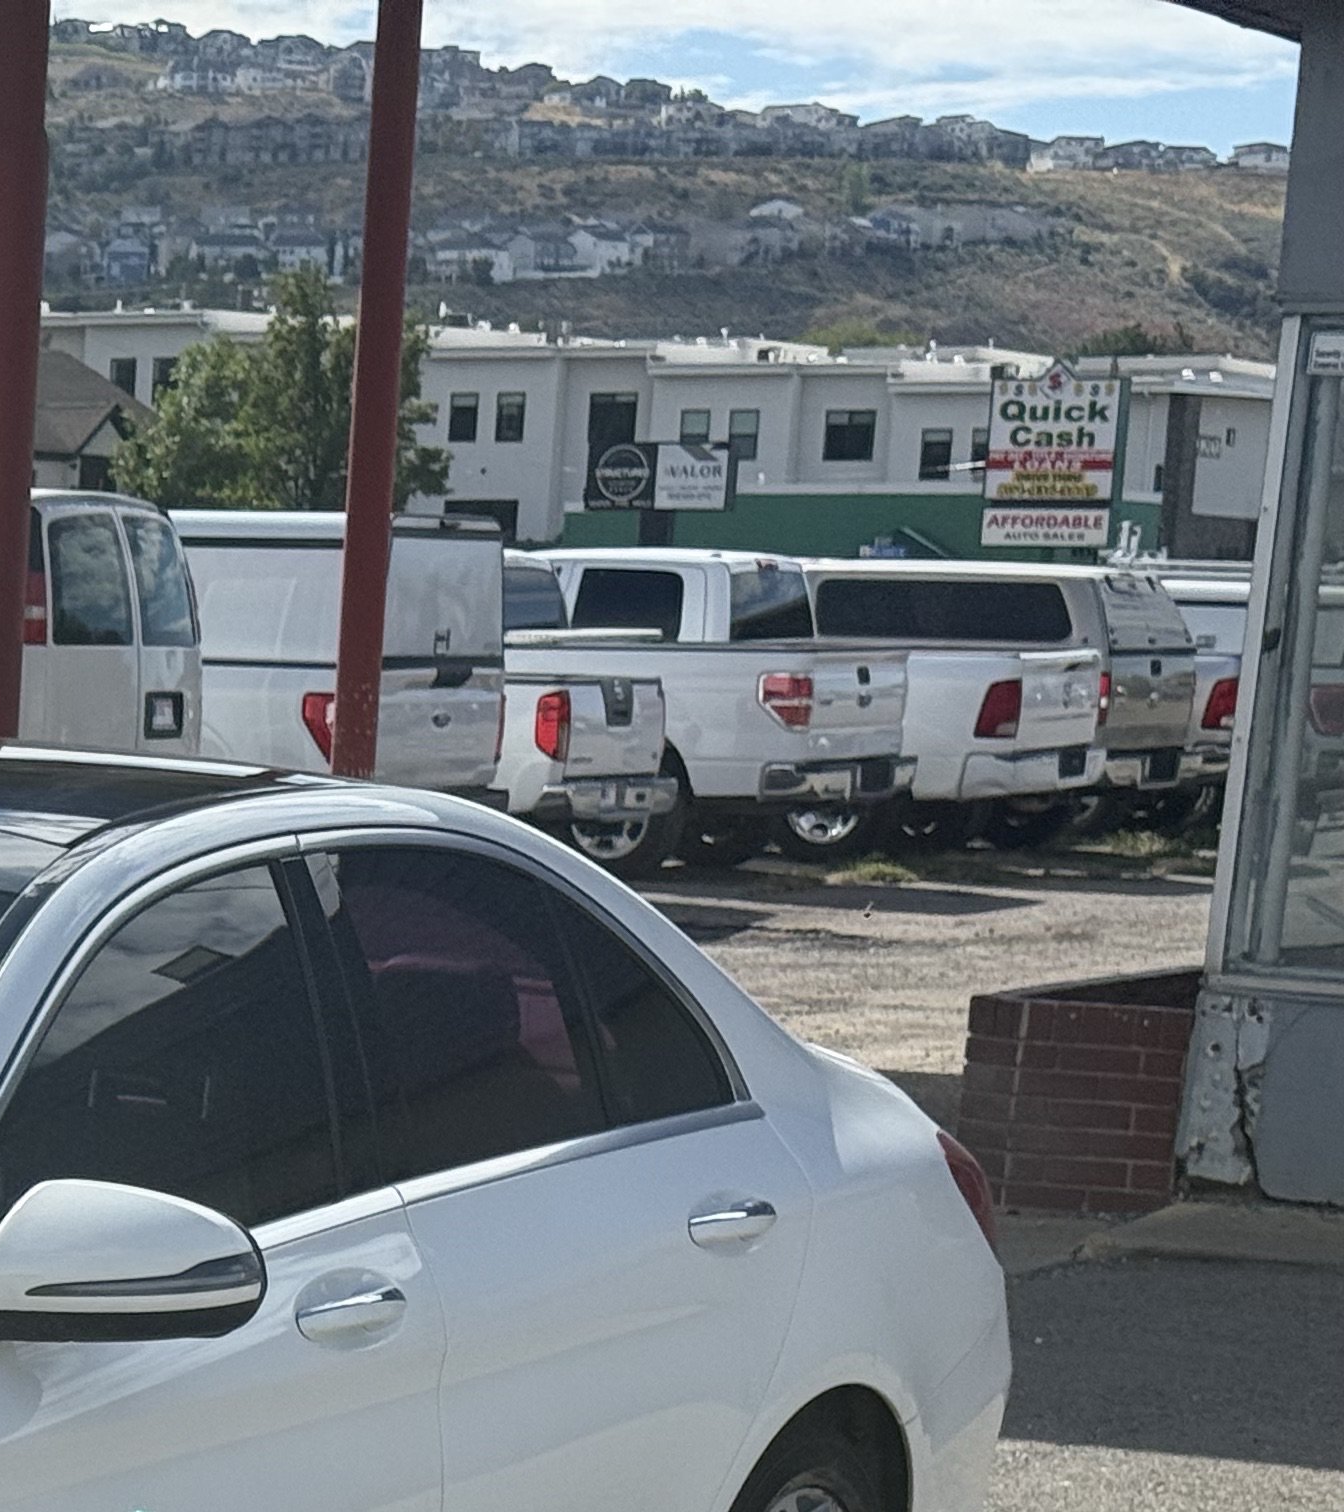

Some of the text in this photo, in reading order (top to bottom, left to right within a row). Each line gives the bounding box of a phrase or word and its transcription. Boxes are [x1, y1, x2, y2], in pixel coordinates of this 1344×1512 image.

[999, 399, 1109, 423] Quick
[1009, 425, 1096, 448] Cash
[670, 464, 722, 479] VALOR
[986, 513, 1104, 530] AFFORDABLE
[1004, 531, 1039, 541] AUTO
